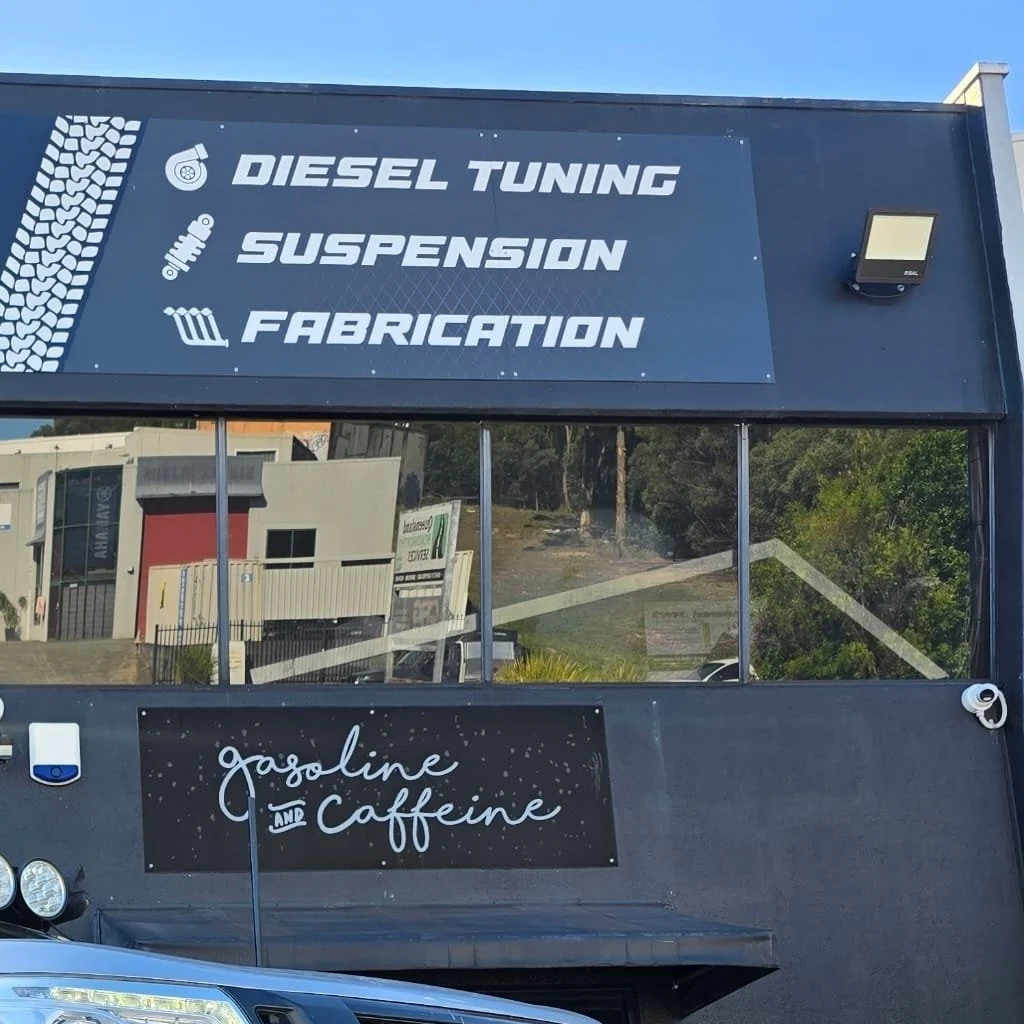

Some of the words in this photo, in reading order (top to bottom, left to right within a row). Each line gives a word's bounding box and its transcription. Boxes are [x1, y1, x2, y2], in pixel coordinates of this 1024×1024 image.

[232, 153, 448, 191] DIESEL
[468, 160, 680, 196] TUNING
[237, 231, 627, 271] SUSPENSION
[241, 310, 645, 349] FABRICATION
[219, 725, 459, 821] gasoline
[271, 803, 306, 831] AND
[317, 787, 562, 853] Caffeine
